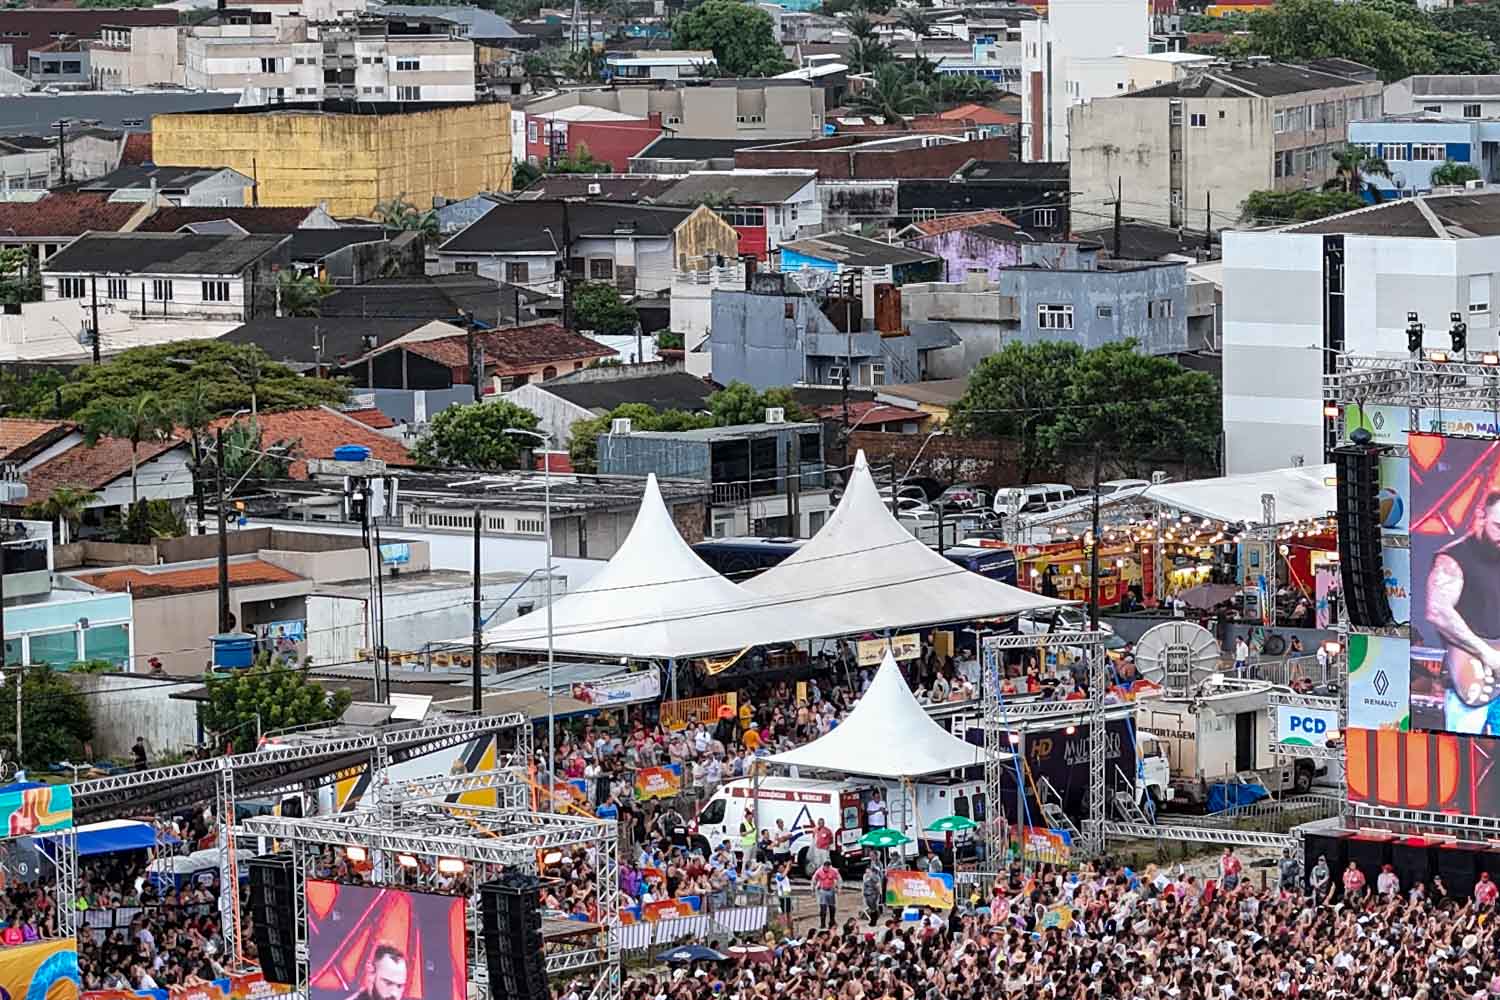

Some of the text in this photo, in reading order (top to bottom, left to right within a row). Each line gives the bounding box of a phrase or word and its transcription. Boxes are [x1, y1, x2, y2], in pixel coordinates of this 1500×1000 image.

[1364, 698, 1398, 708] RENAULT
[1290, 716, 1326, 734] PCD
[1032, 738, 1054, 757] HD
